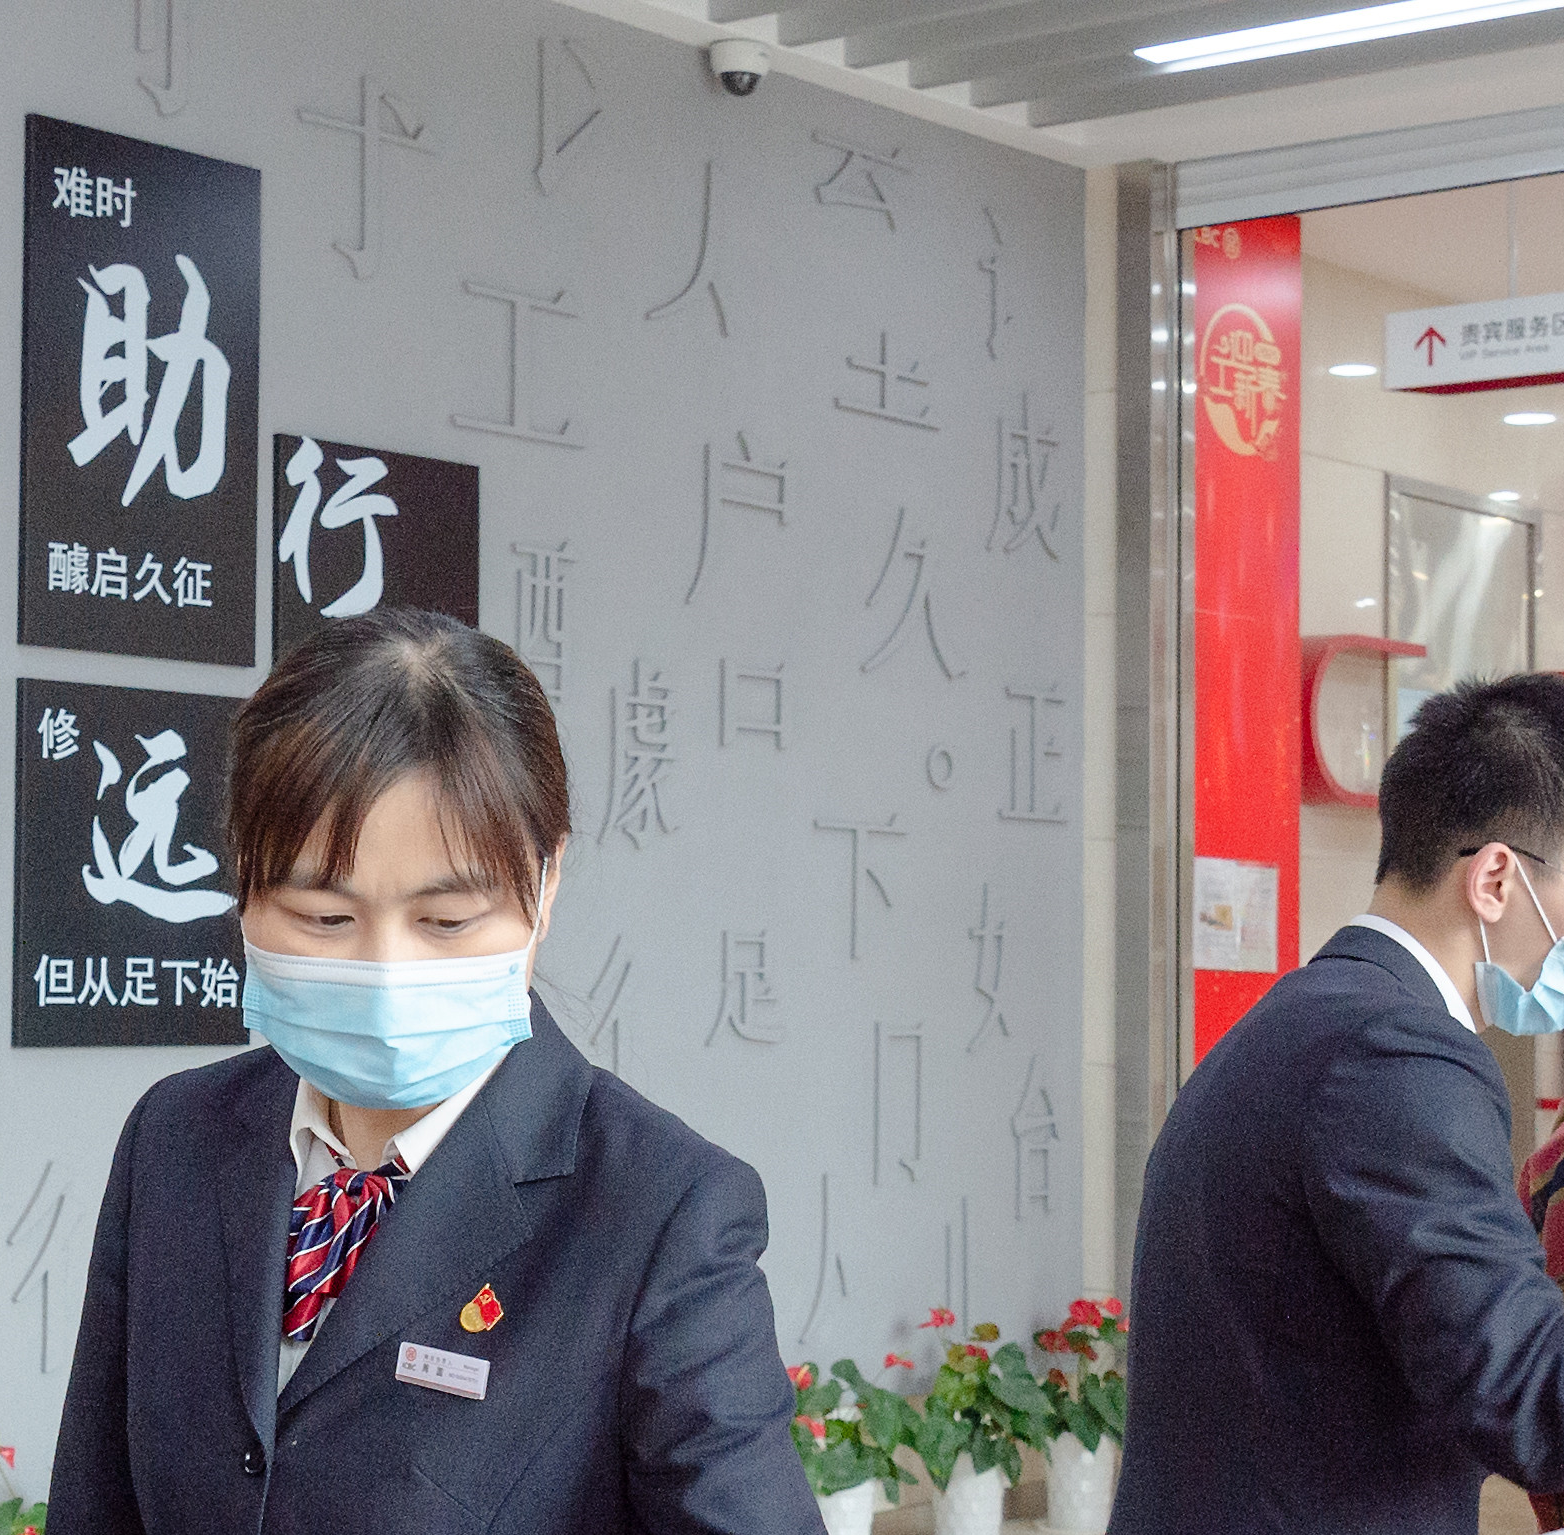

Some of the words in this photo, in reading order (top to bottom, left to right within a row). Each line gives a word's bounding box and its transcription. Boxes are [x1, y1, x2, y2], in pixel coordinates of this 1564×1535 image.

[53, 167, 137, 228] 难时
[68, 255, 231, 507] 助
[279, 436, 398, 618] 行
[37, 707, 80, 760] 修
[82, 730, 239, 924] 远
[33, 954, 240, 1010] 但从足下始
